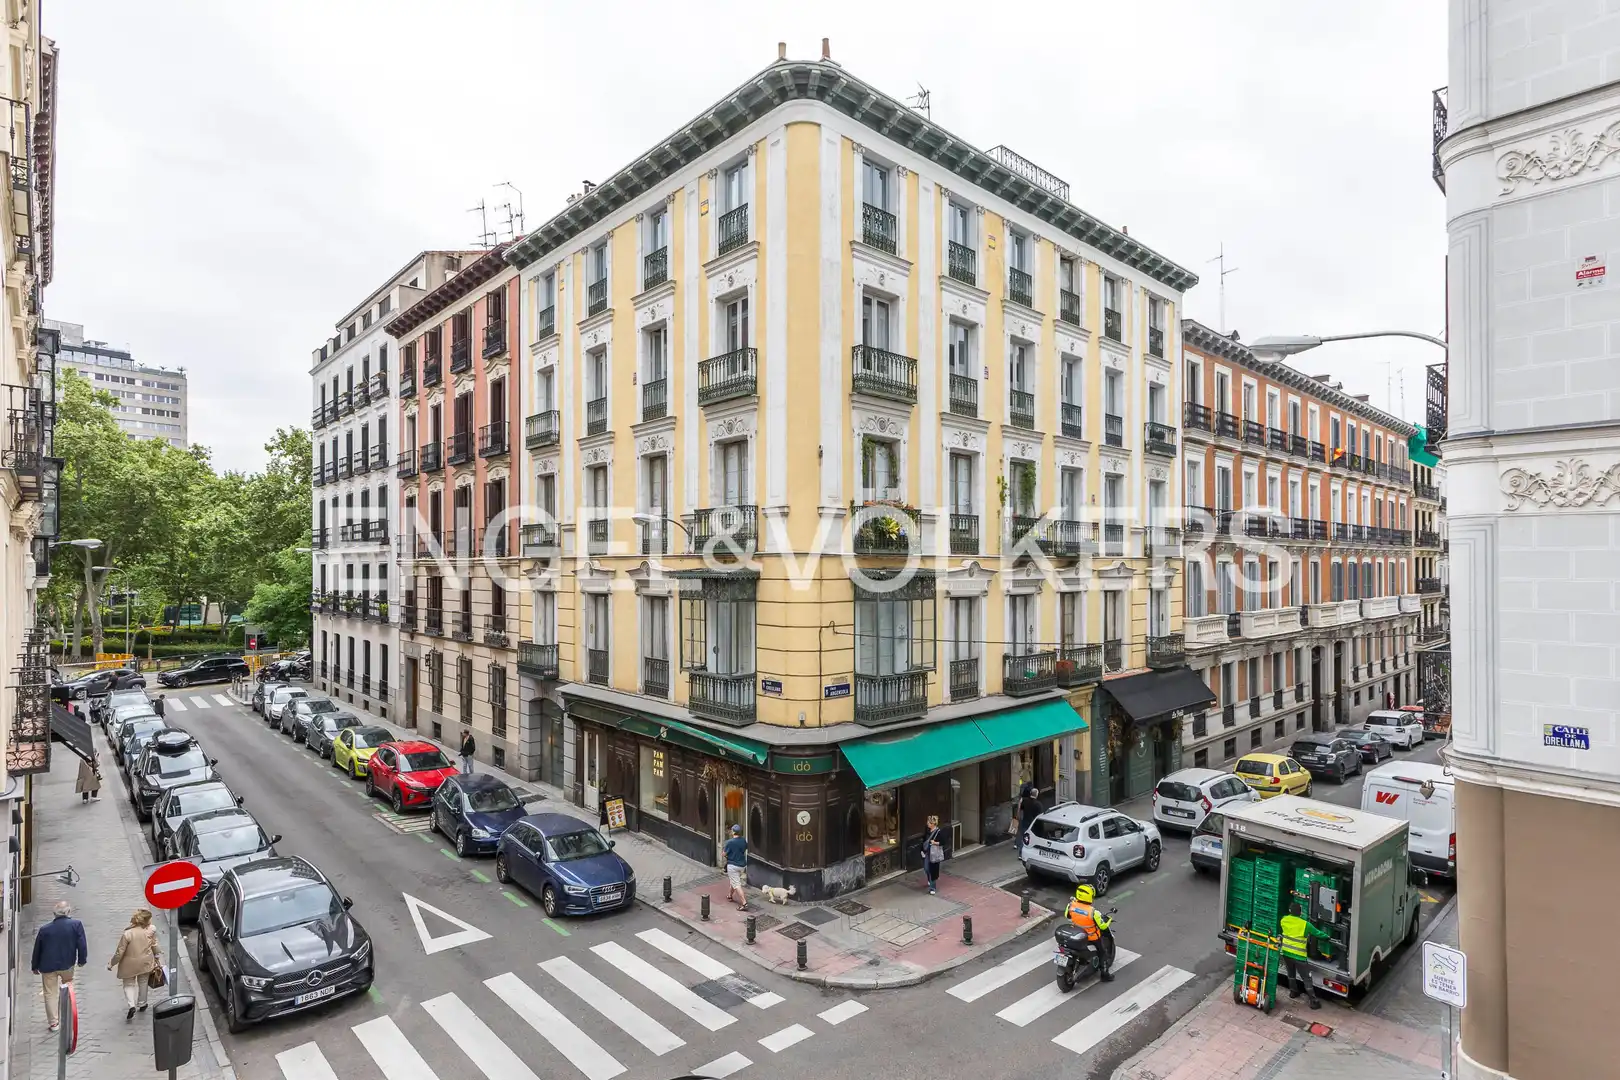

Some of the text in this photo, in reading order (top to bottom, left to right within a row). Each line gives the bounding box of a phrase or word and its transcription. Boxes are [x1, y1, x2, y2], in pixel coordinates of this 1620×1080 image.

[1555, 726, 1588, 735] CALLE
[1545, 736, 1586, 749] ORELLANA
[1229, 822, 1246, 832] 118
